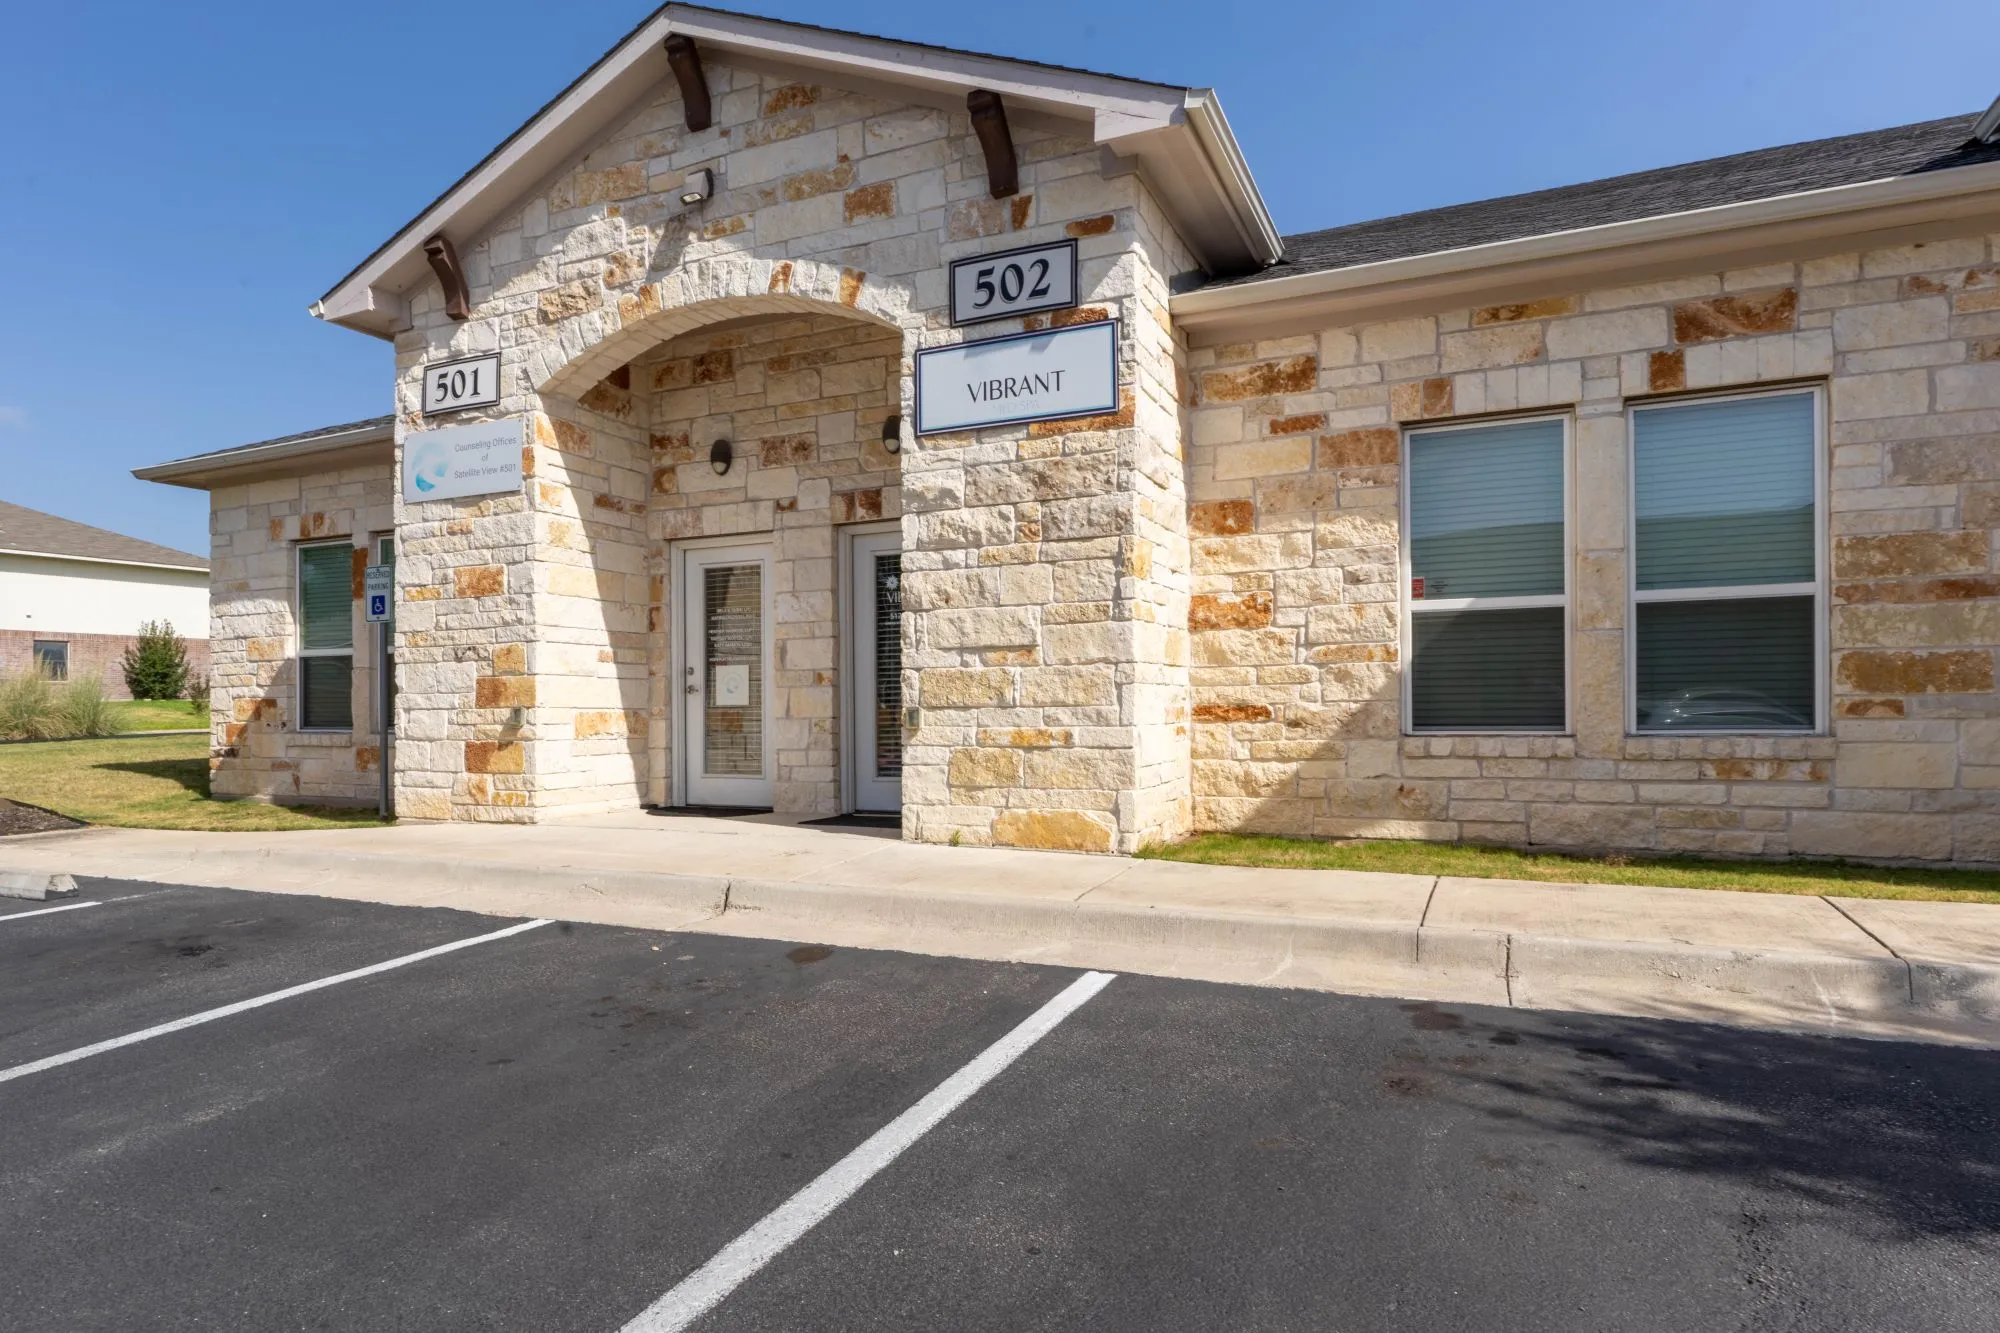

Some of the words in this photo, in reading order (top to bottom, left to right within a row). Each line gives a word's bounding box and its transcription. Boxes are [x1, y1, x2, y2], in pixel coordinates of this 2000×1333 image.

[972, 258, 1051, 309] 502
[435, 367, 480, 403] 501
[967, 370, 1065, 403] VIBRANT
[454, 440, 491, 453] Counseling
[492, 437, 517, 447] Offices
[481, 452, 488, 461] of
[454, 468, 480, 479] Satellite
[481, 466, 498, 475] View
[500, 463, 516, 472] #501
[366, 571, 389, 579] RESERVED
[367, 583, 389, 591] PARKING
